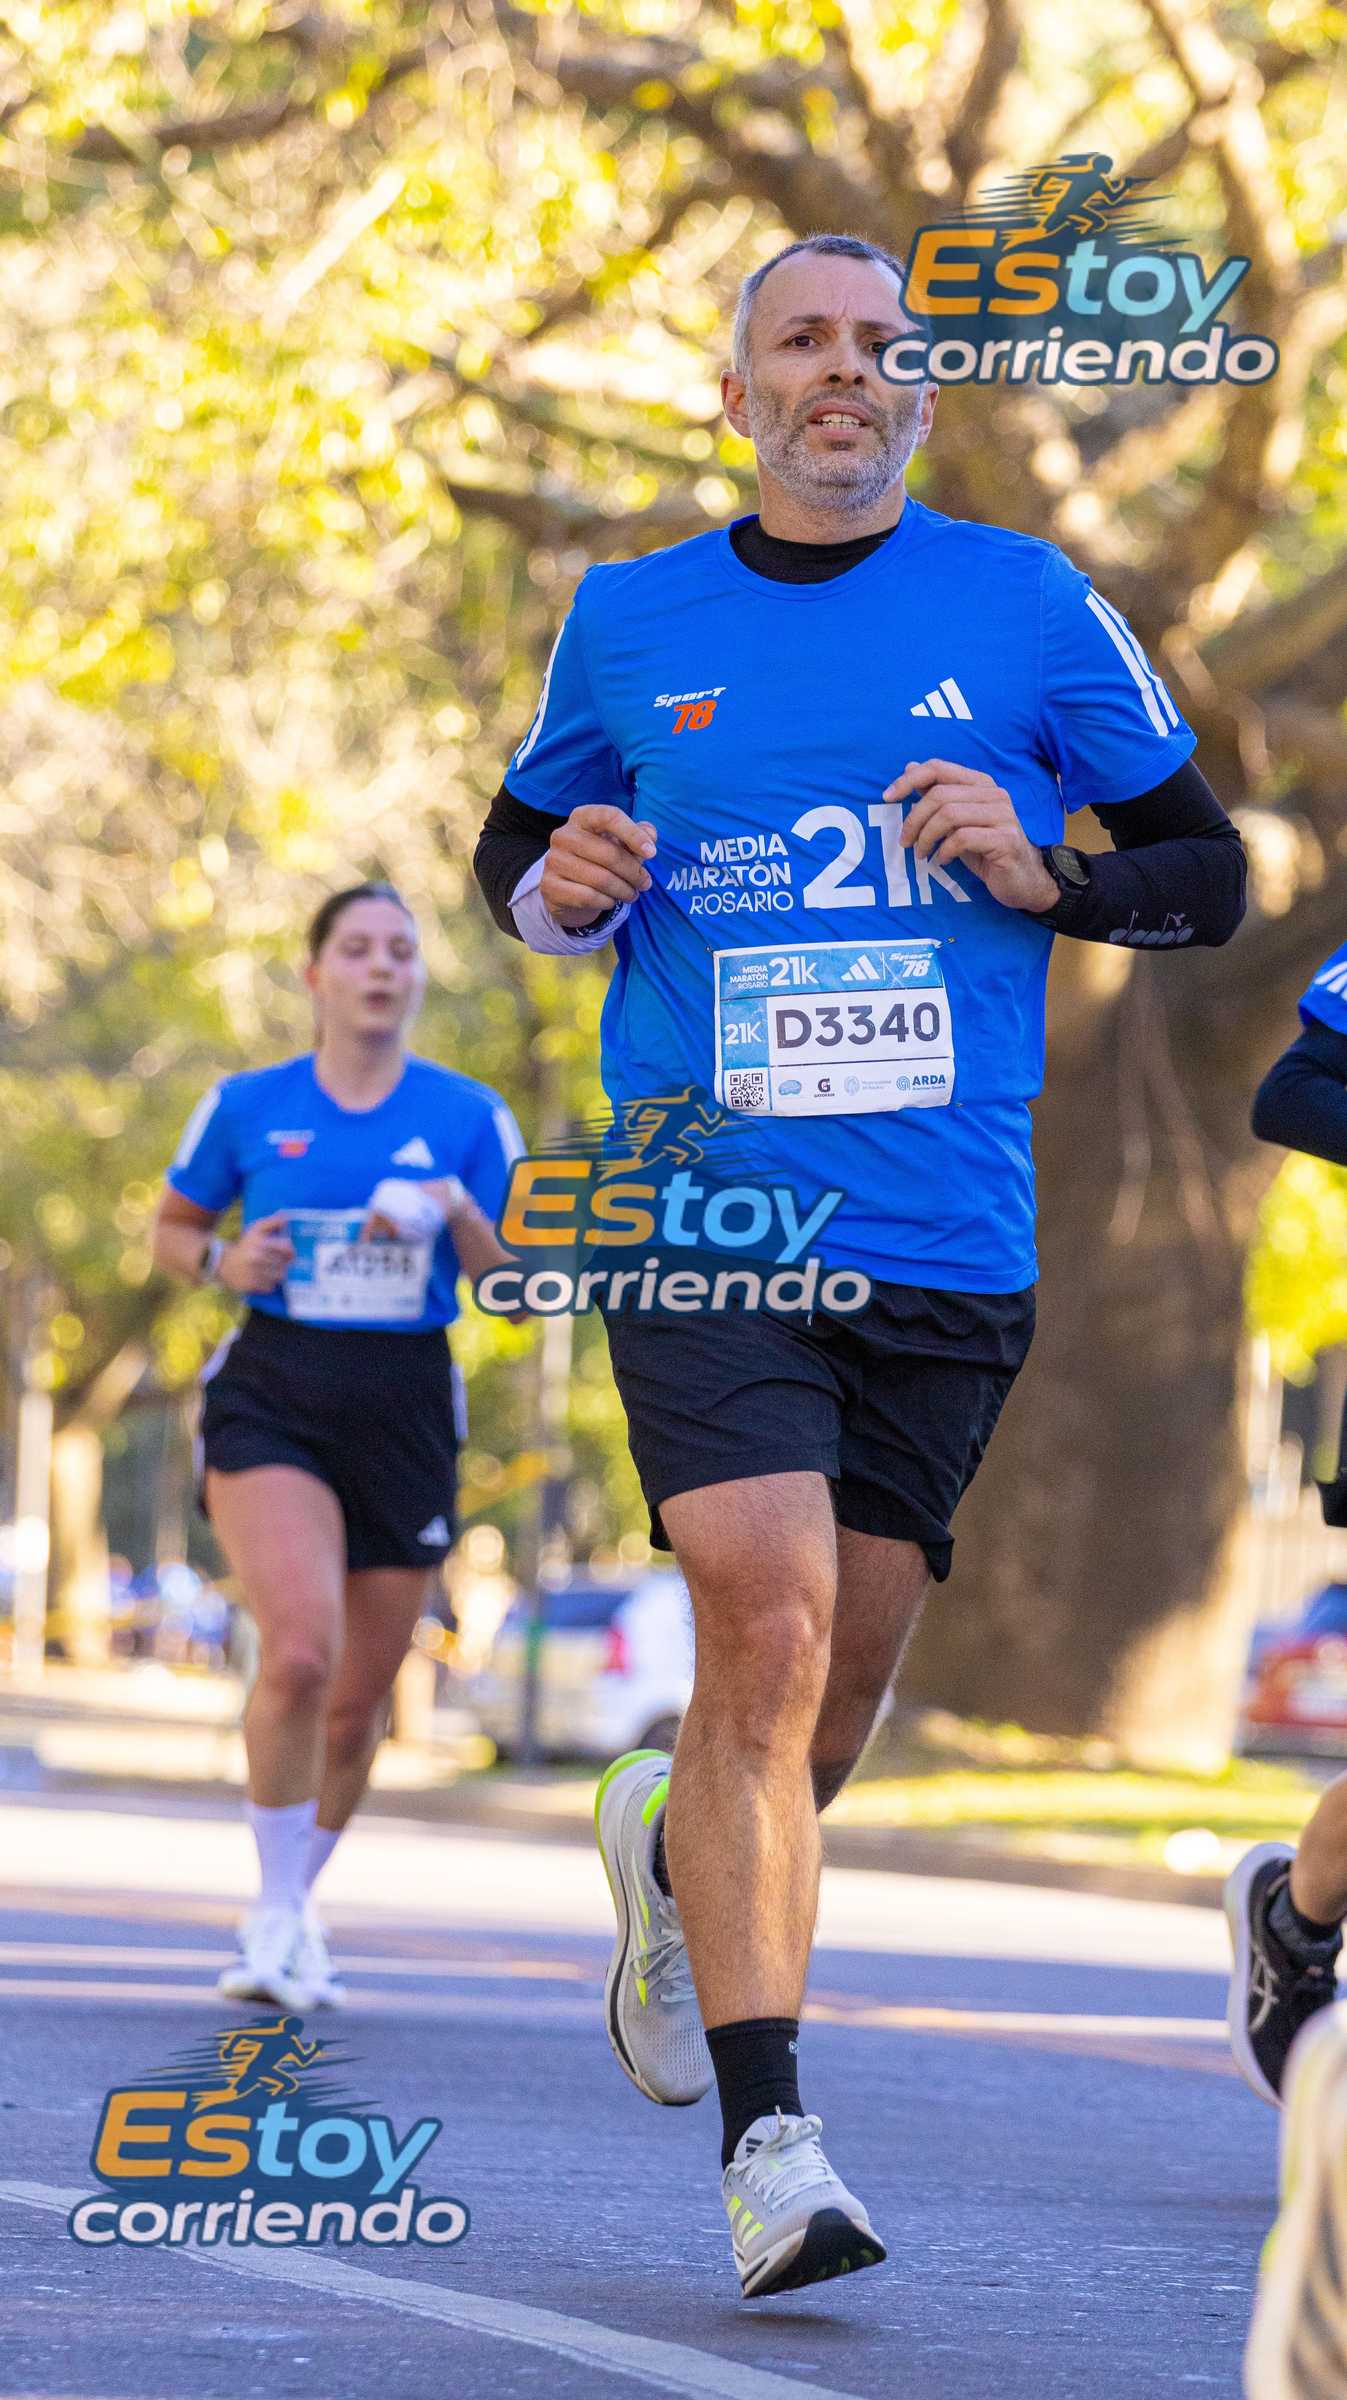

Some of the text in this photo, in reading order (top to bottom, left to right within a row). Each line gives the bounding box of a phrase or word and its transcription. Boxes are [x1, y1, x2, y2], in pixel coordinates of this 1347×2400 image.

[672, 699, 718, 735] 78
[700, 833, 789, 866] MEDIA
[666, 861, 792, 891] MARATÓN
[689, 890, 794, 915] ROSARIO
[742, 964, 769, 974] MEDIA
[902, 959, 931, 978] 78
[724, 1022, 762, 1045] 21K
[776, 1002, 940, 1049] D3340
[912, 1074, 946, 1086] ARDA
